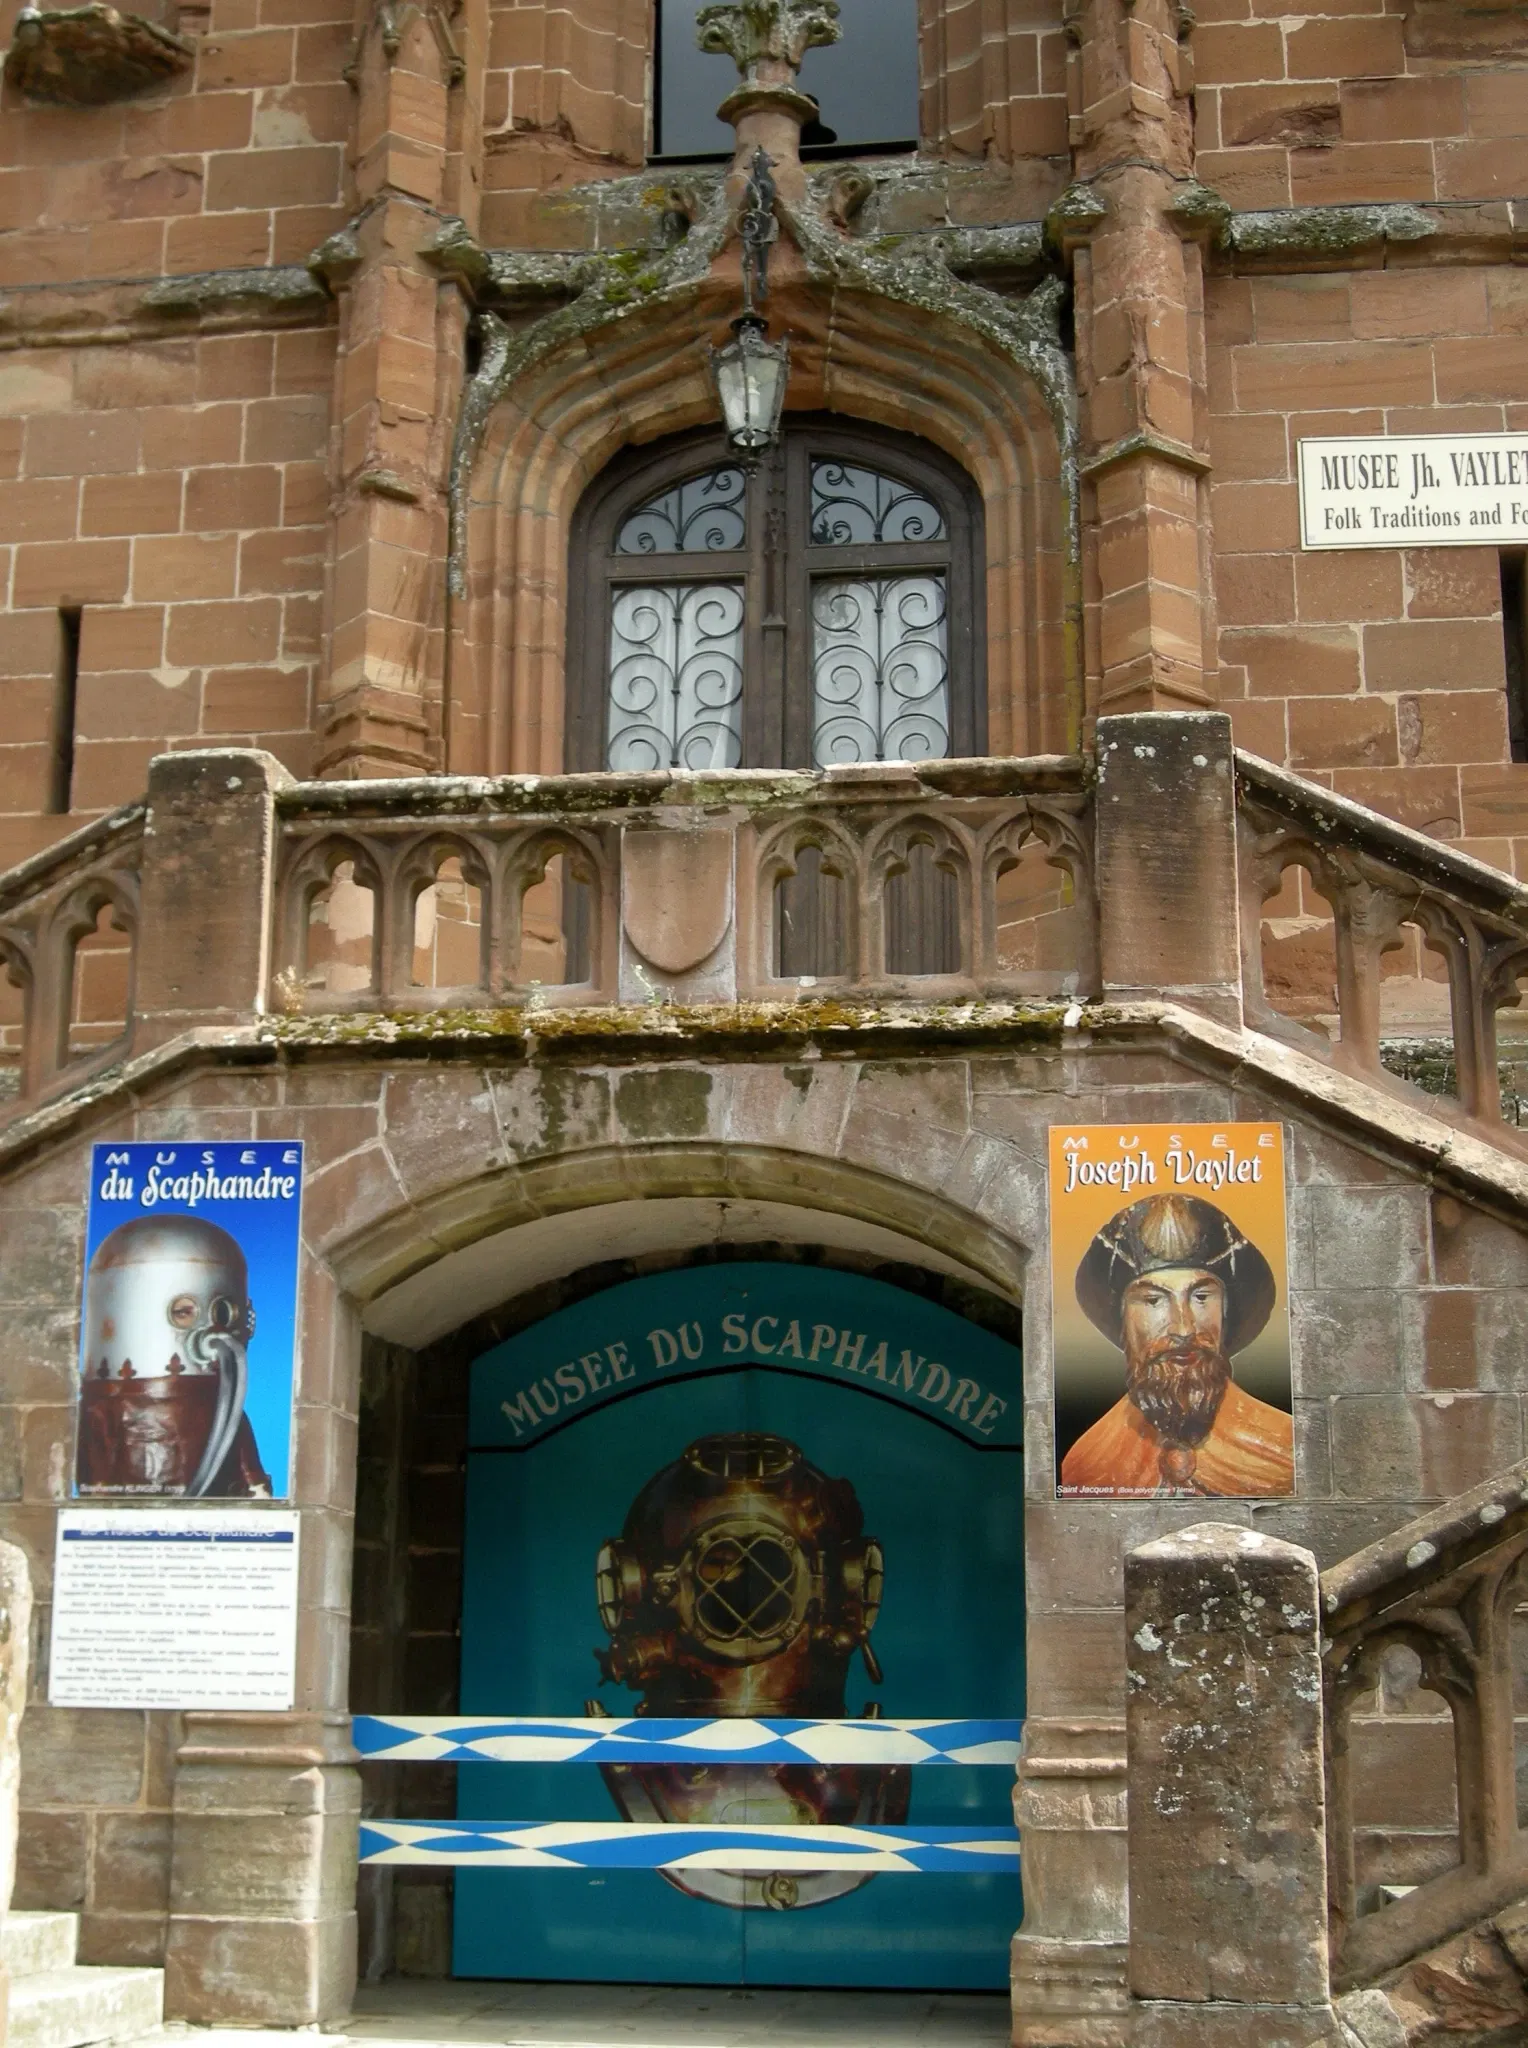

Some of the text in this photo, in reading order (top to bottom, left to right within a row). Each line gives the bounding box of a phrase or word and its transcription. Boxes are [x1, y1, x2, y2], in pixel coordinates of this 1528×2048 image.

[1321, 454, 1400, 490] MUSEE
[1411, 453, 1440, 499] Jh.
[1324, 507, 1362, 530] Folk
[1370, 504, 1461, 529] Traditions
[1469, 503, 1502, 525] and
[1062, 1133, 1276, 1150] MUSEE
[105, 1150, 300, 1166] MUSEE
[1065, 1149, 1263, 1193] Joseph Vaylet
[100, 1165, 296, 1207] du Scaphandre
[500, 1313, 1008, 1437] MUSEE DU SCAPHANDRE
[1056, 1485, 1078, 1493] Saint
[1079, 1485, 1114, 1495] Jacques
[80, 1520, 98, 1537] Le
[159, 1520, 178, 1538] du
[183, 1520, 276, 1542] Scaphandre
